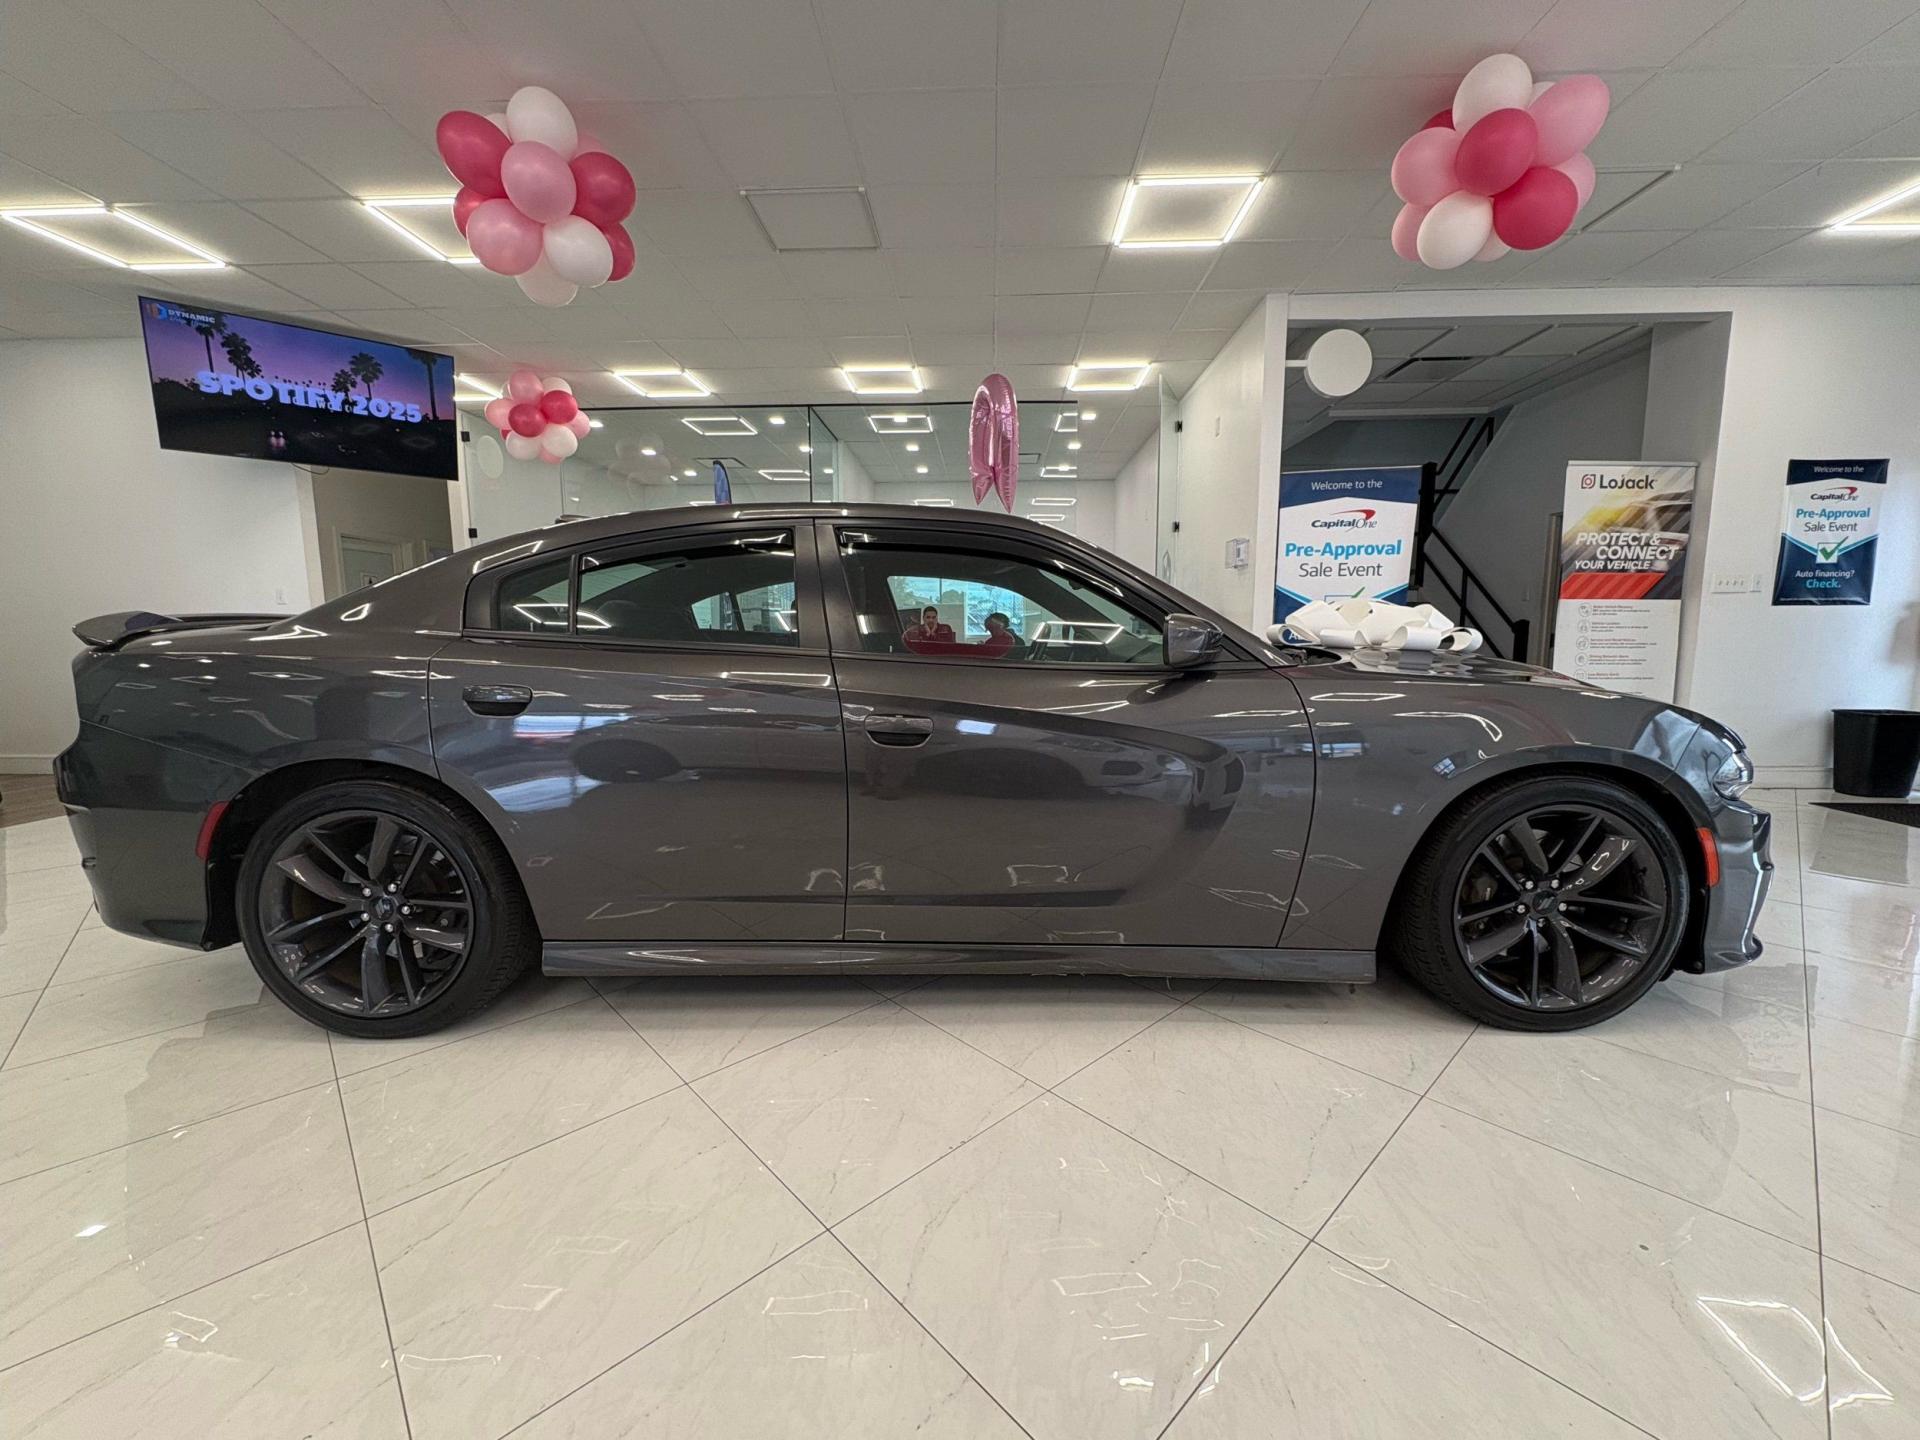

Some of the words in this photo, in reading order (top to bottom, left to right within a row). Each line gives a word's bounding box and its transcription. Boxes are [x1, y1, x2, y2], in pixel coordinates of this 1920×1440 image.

[167, 309, 216, 324] DYNAMIC
[196, 370, 347, 412] SPOTIFY
[351, 395, 423, 423] 2025
[1311, 480, 1353, 491] Welcome
[1356, 479, 1365, 489] to
[1367, 479, 1383, 489] the
[1796, 508, 1871, 520] Pre-Approval
[1804, 522, 1826, 532] Sale
[1829, 522, 1858, 532] Event
[1575, 532, 1650, 546] PROTECT
[1285, 539, 1402, 560] Pre-Approval
[1596, 545, 1679, 560] CONNECT
[1299, 561, 1333, 577] Sale
[1338, 562, 1383, 577] Event
[1575, 560, 1605, 569] YOUR
[1607, 560, 1651, 569] VEHICLE
[1795, 570, 1814, 578] Auto
[1815, 570, 1855, 579] financing?
[1805, 579, 1841, 589] Check.
